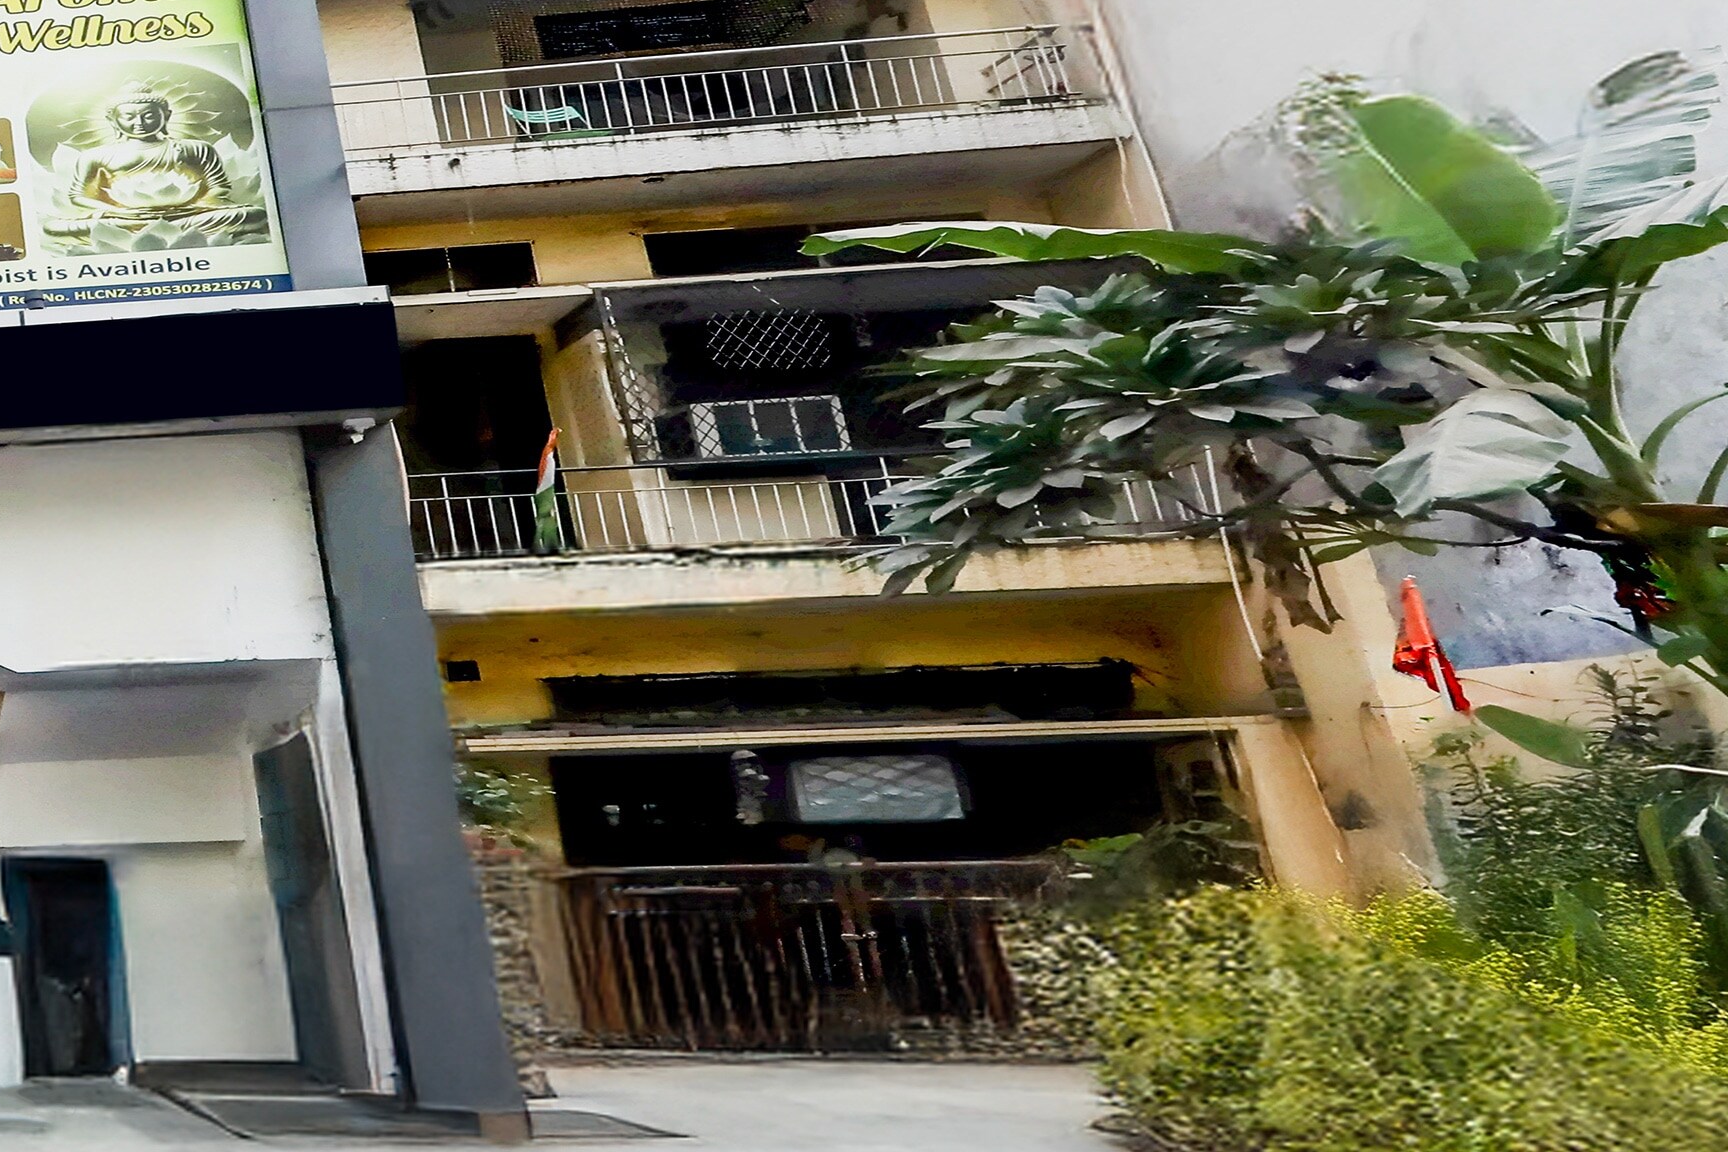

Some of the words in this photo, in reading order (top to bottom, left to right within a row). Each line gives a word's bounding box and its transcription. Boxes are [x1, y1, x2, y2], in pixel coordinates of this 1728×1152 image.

[47, 265, 68, 281] is
[77, 256, 211, 279] Available
[42, 293, 70, 303] No.
